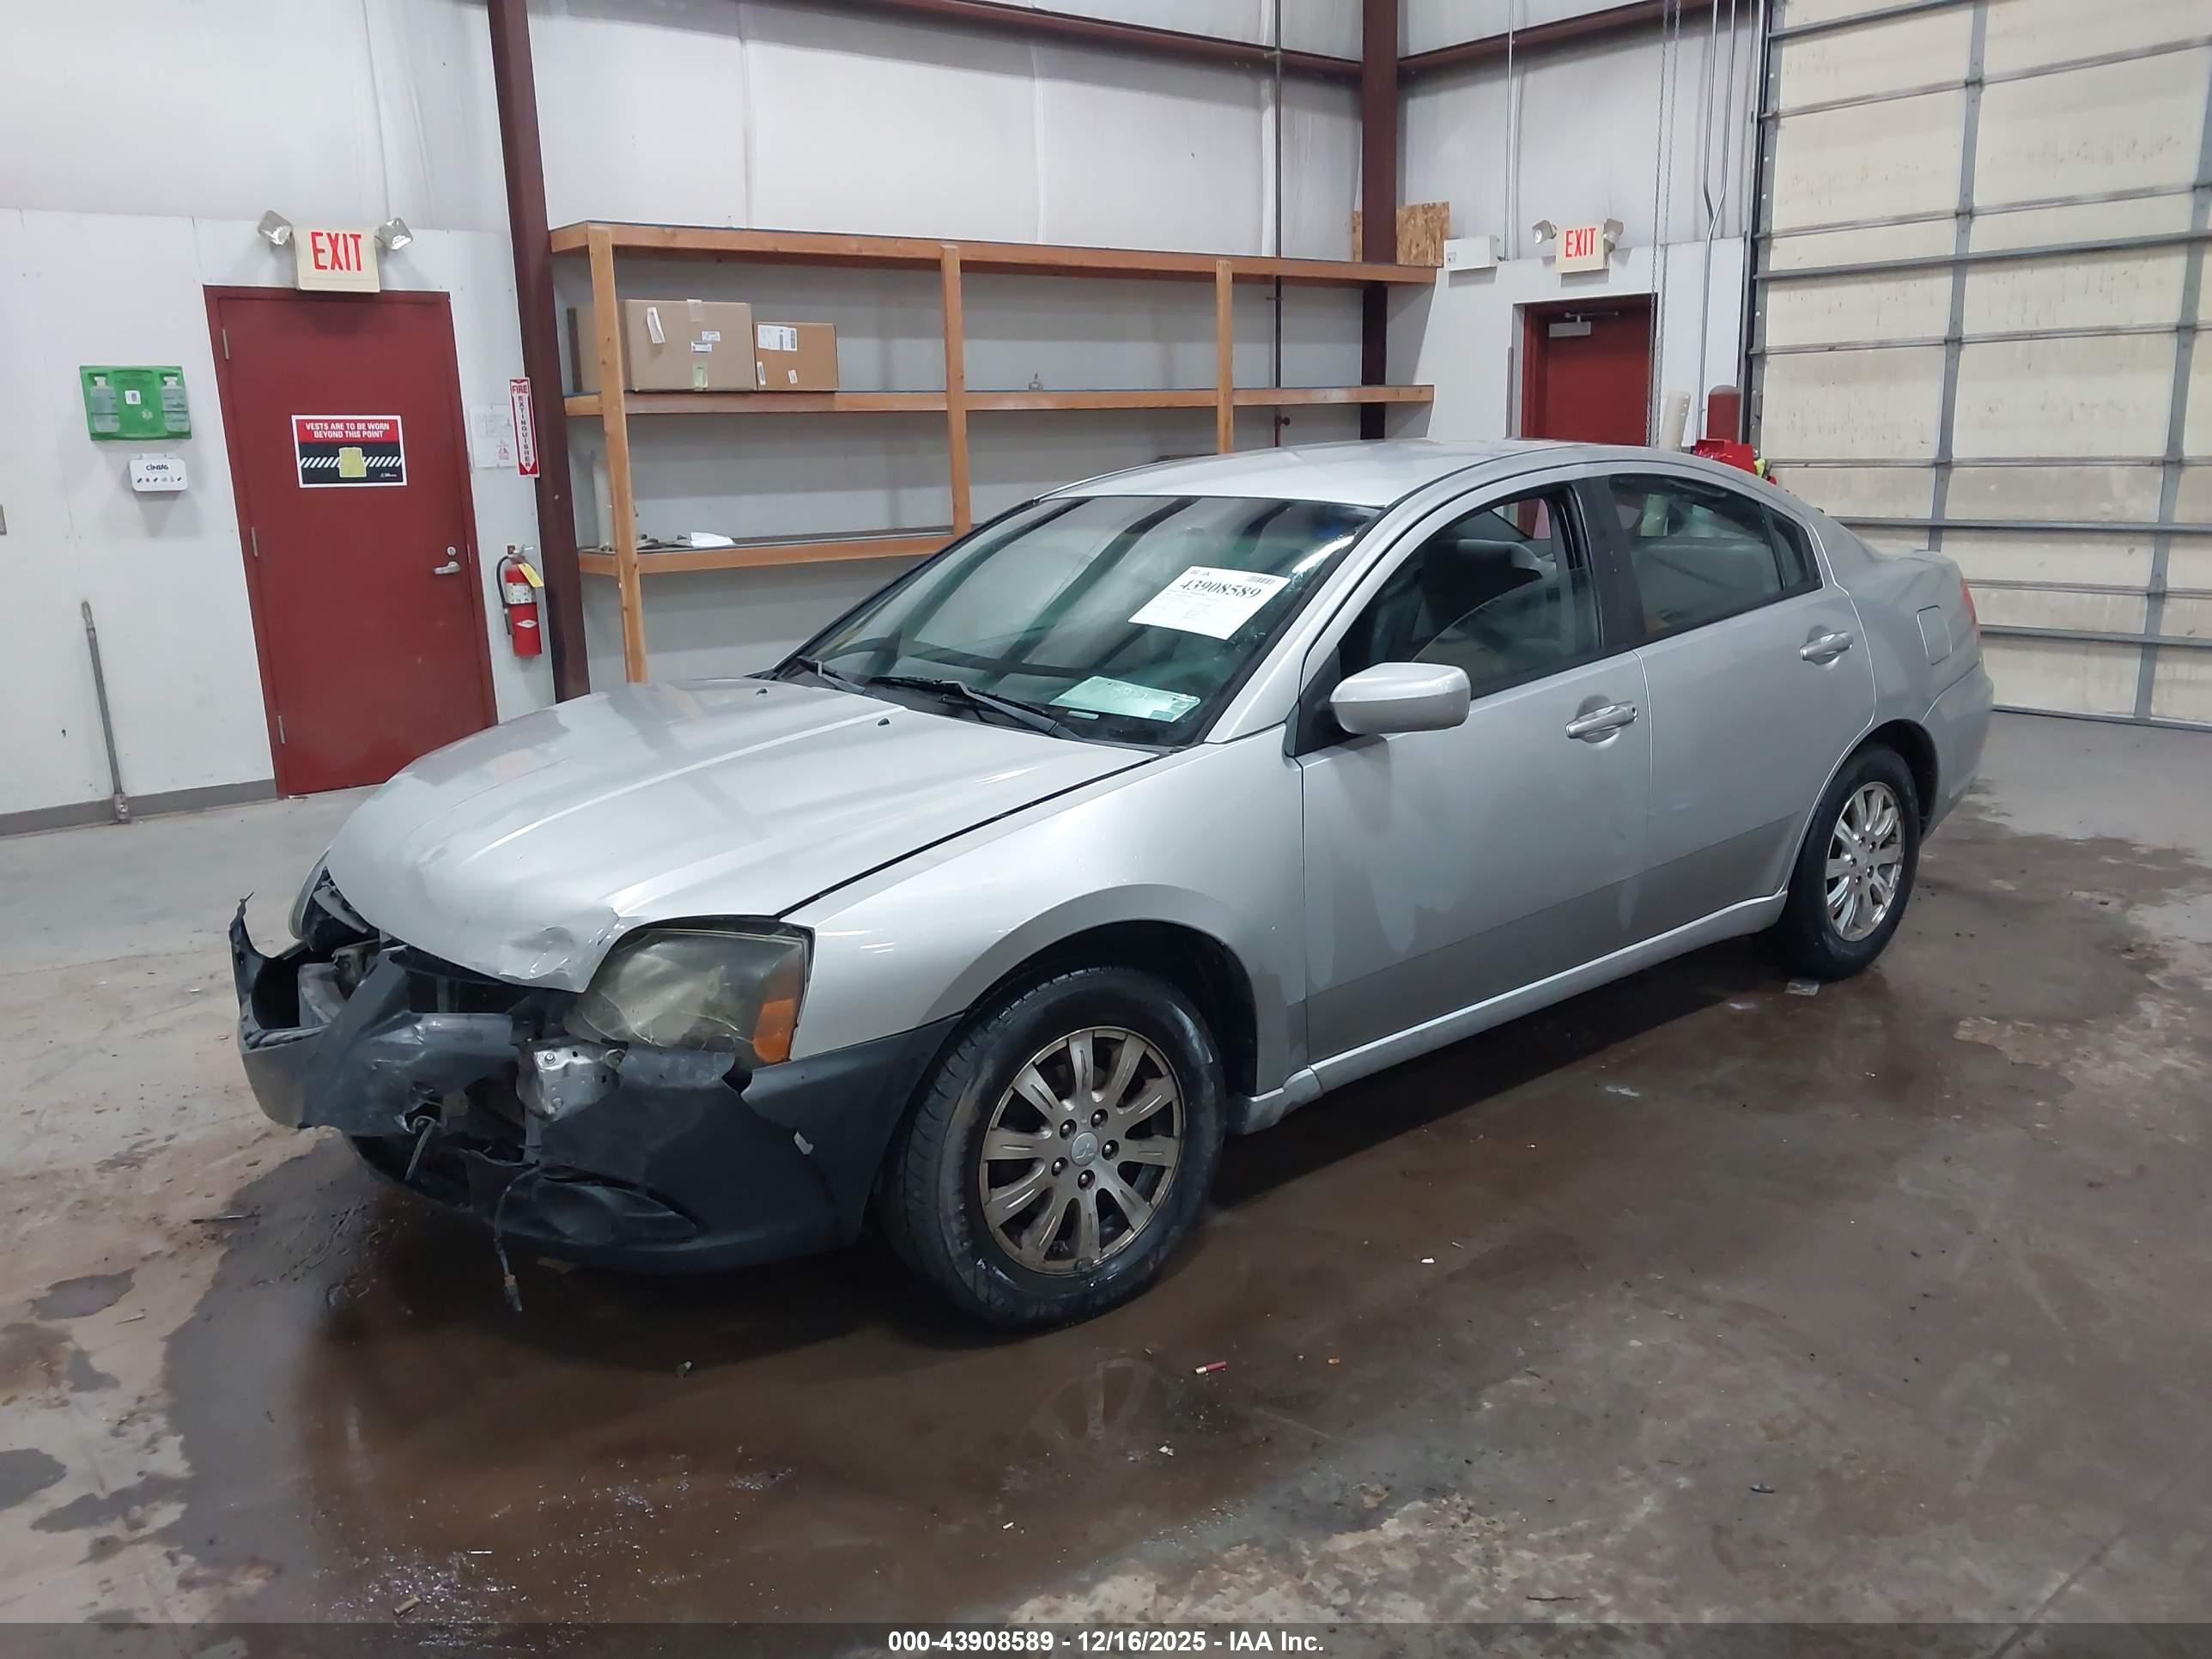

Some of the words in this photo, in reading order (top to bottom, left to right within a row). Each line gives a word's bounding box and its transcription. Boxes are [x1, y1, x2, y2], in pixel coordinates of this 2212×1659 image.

[311, 231, 362, 271] EXIT
[1565, 227, 1596, 258] EXIT
[513, 385, 528, 394] FIRE
[519, 396, 531, 467] EXTINGUISHER
[1180, 579, 1262, 599] 43908589
